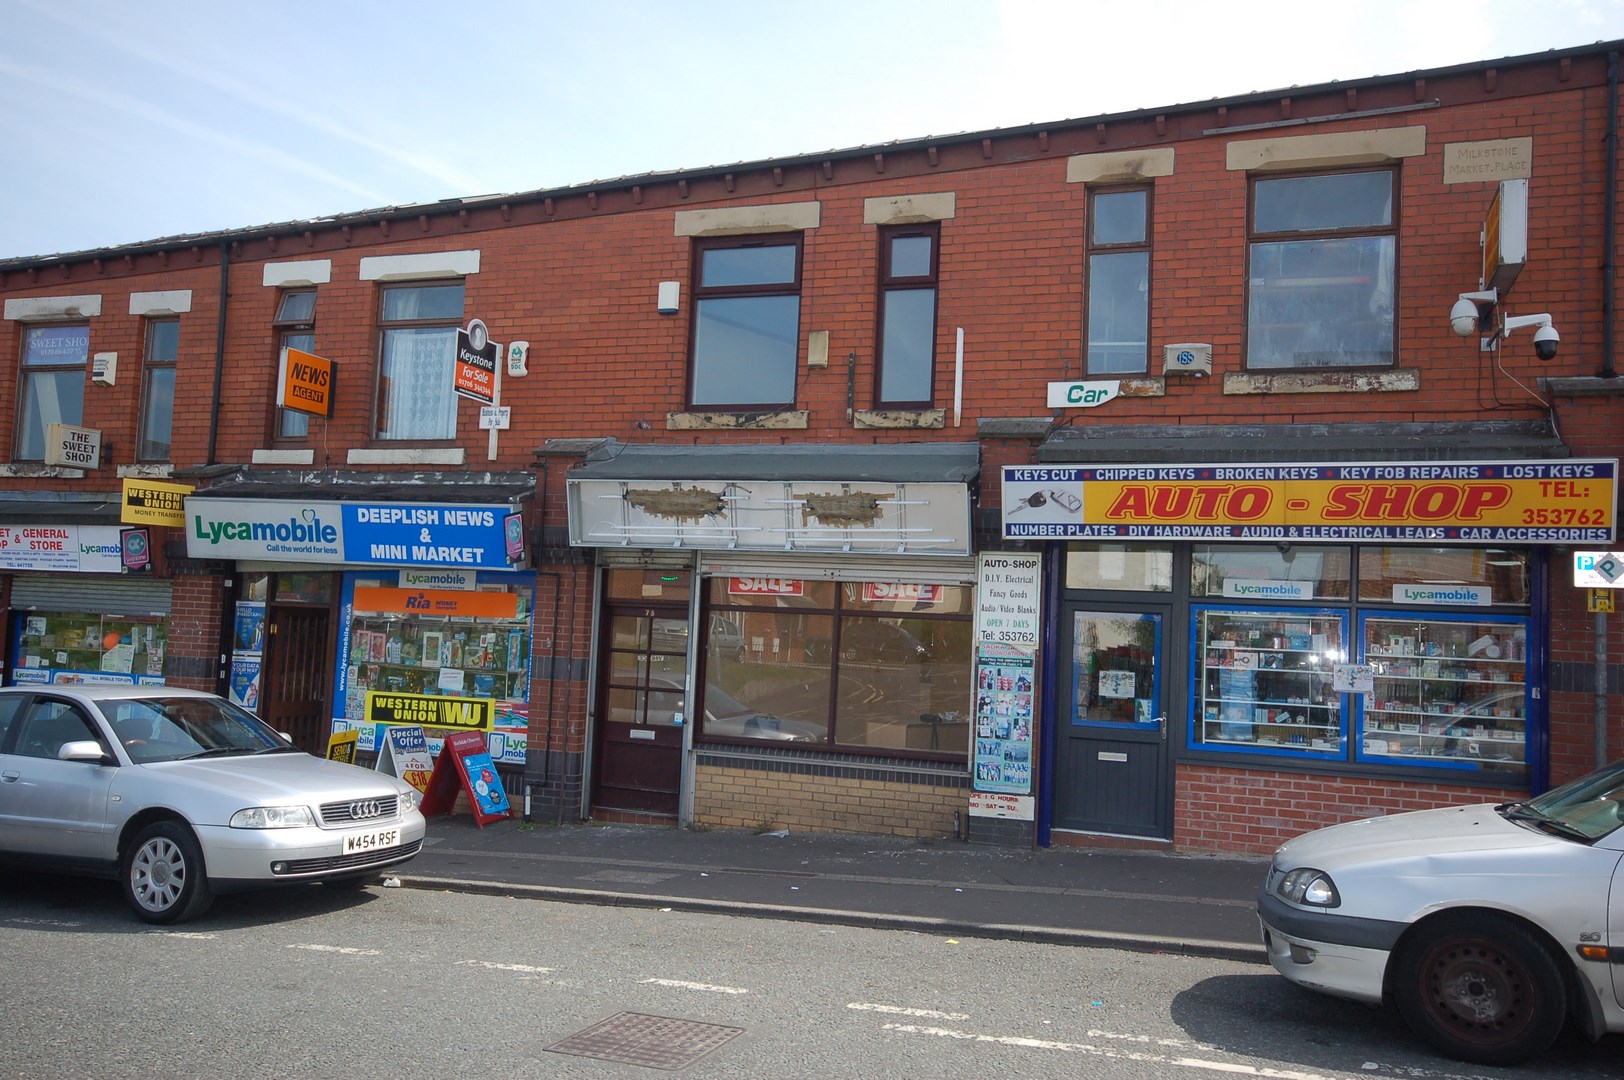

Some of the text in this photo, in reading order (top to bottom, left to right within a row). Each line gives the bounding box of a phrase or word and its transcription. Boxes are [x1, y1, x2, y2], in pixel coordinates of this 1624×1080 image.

[1458, 147, 1518, 159] MILKSTONE
[1496, 161, 1527, 171] PLACE
[31, 337, 64, 349] SWEET
[460, 348, 493, 370] Keystone
[291, 361, 329, 387] NEWS
[462, 366, 489, 384] For Sale
[458, 378, 474, 389] 01706
[474, 382, 491, 396] 344344
[1067, 385, 1108, 403] Car
[294, 387, 324, 402] AGENT
[70, 432, 90, 444] THE
[62, 441, 96, 454] SWEET
[65, 452, 92, 463] SHOP
[1014, 465, 1595, 481] KEYS CUT CHIPPED KEYS BROKEN KEYS KEY FOB REPAIRS LOST KEYS
[128, 488, 180, 502] WESTERN
[1538, 481, 1590, 498] TEL:
[144, 498, 180, 510] UNION
[1106, 484, 1273, 520] AUTO
[1321, 484, 1512, 520] SHOP
[358, 508, 494, 527] DEEPLISH NEWS
[1522, 508, 1605, 526] 353762
[14, 534, 20, 544] &
[22, 528, 69, 539] GENERAL
[195, 514, 338, 545] Lycamobile
[420, 528, 432, 543] &
[1010, 526, 1608, 541] NUMBER PLATES DIY HARDWARE AUDIO & ELECTRICAL LEADS CAR ACCESSORIES
[30, 540, 62, 550] STORE
[80, 543, 121, 554] Lycamob
[266, 544, 338, 555] Call the world for less
[370, 544, 484, 563] MINI MARKET
[984, 560, 1037, 568] AUTO-SHOP
[406, 573, 466, 584] Lycamobile
[738, 578, 794, 593] SALE
[985, 574, 1034, 584] D.I.Y. Electrical
[874, 582, 933, 600] SALE
[990, 589, 1028, 600] Fancy Goods
[1234, 584, 1301, 594] Lycamobile
[1404, 588, 1478, 600] Lycamobile
[406, 592, 431, 609] Ria
[1017, 604, 1036, 614] Blanks
[986, 619, 1030, 629] OPEN 7 DAYS
[981, 631, 1034, 642] Tel: 353762
[340, 603, 352, 691] www.lycamobile.co.uk
[15, 670, 46, 679] Lycamobile
[376, 697, 438, 712] WESTERN
[394, 708, 437, 722] UNION
[444, 702, 482, 725] WU
[392, 728, 422, 738] Special
[400, 736, 423, 746] Offer
[412, 772, 427, 786] £18
[348, 831, 396, 851] W454 RSF
